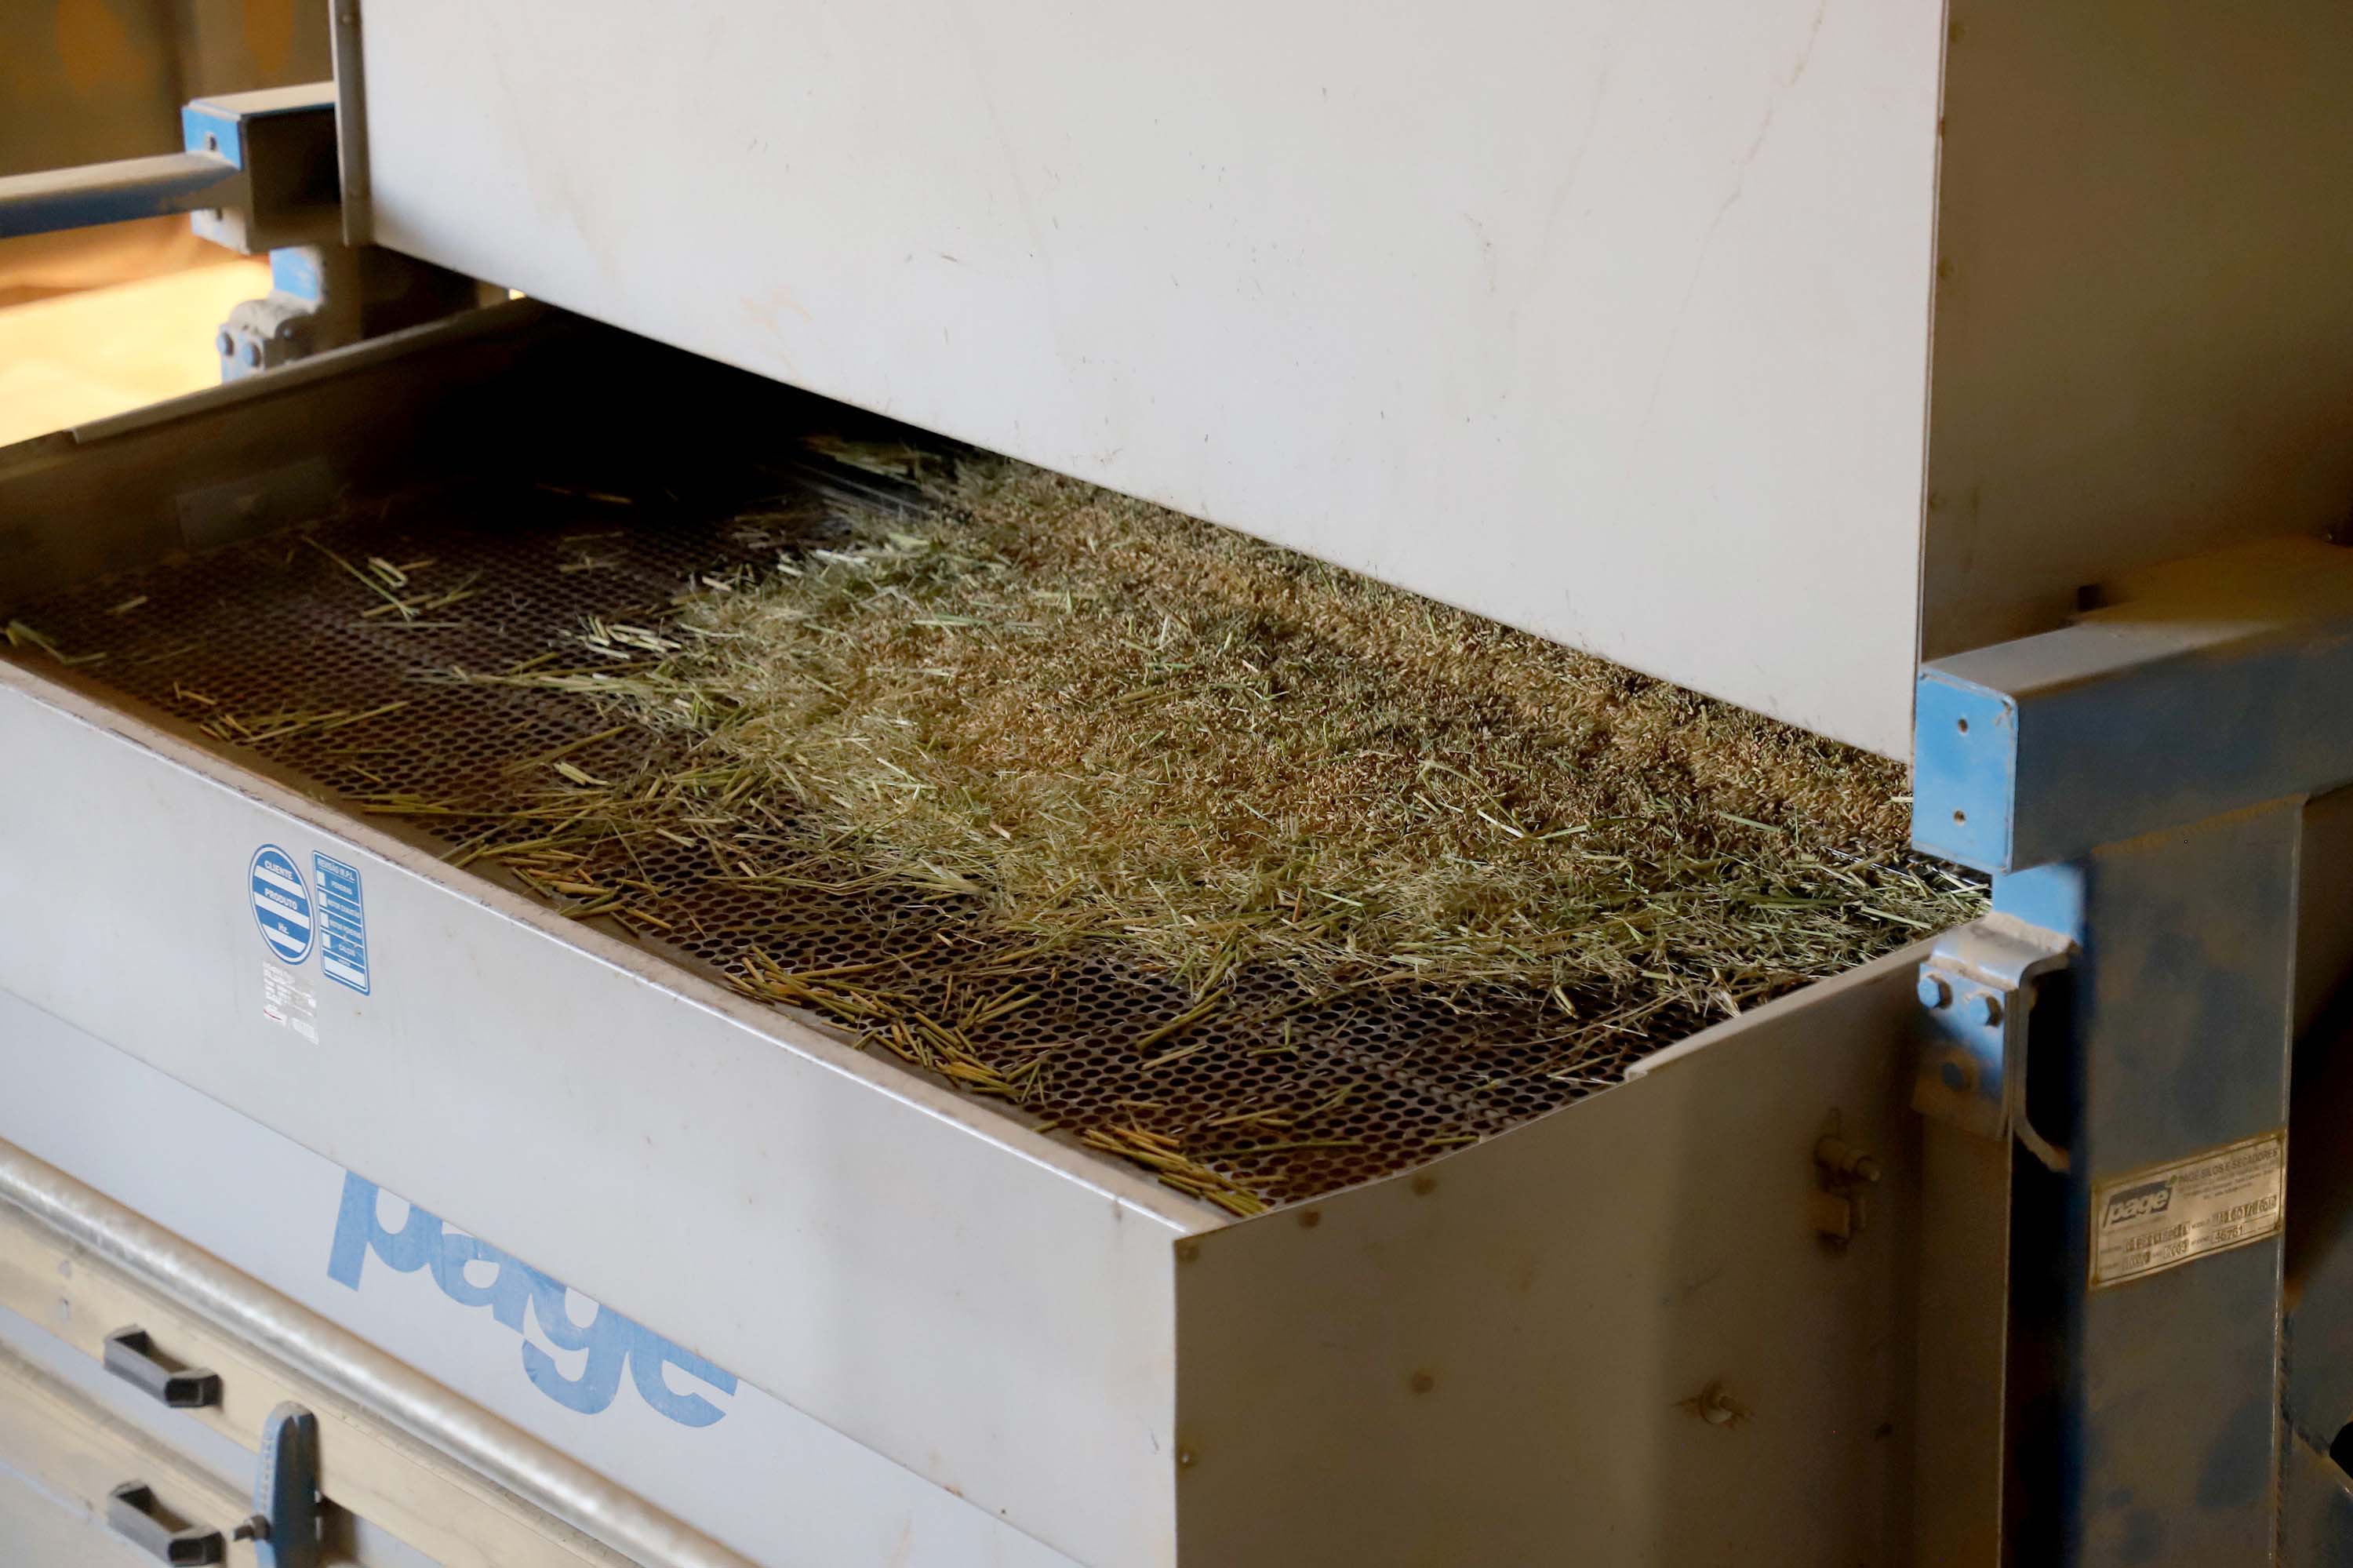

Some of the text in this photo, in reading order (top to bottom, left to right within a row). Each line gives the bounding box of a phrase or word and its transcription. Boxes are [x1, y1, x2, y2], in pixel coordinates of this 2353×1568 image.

[264, 860, 293, 880] CLIENTE
[264, 888, 297, 910] PRODUTO
[2231, 1148, 2278, 1170] SECADORES
[2104, 1188, 2171, 1228] page
